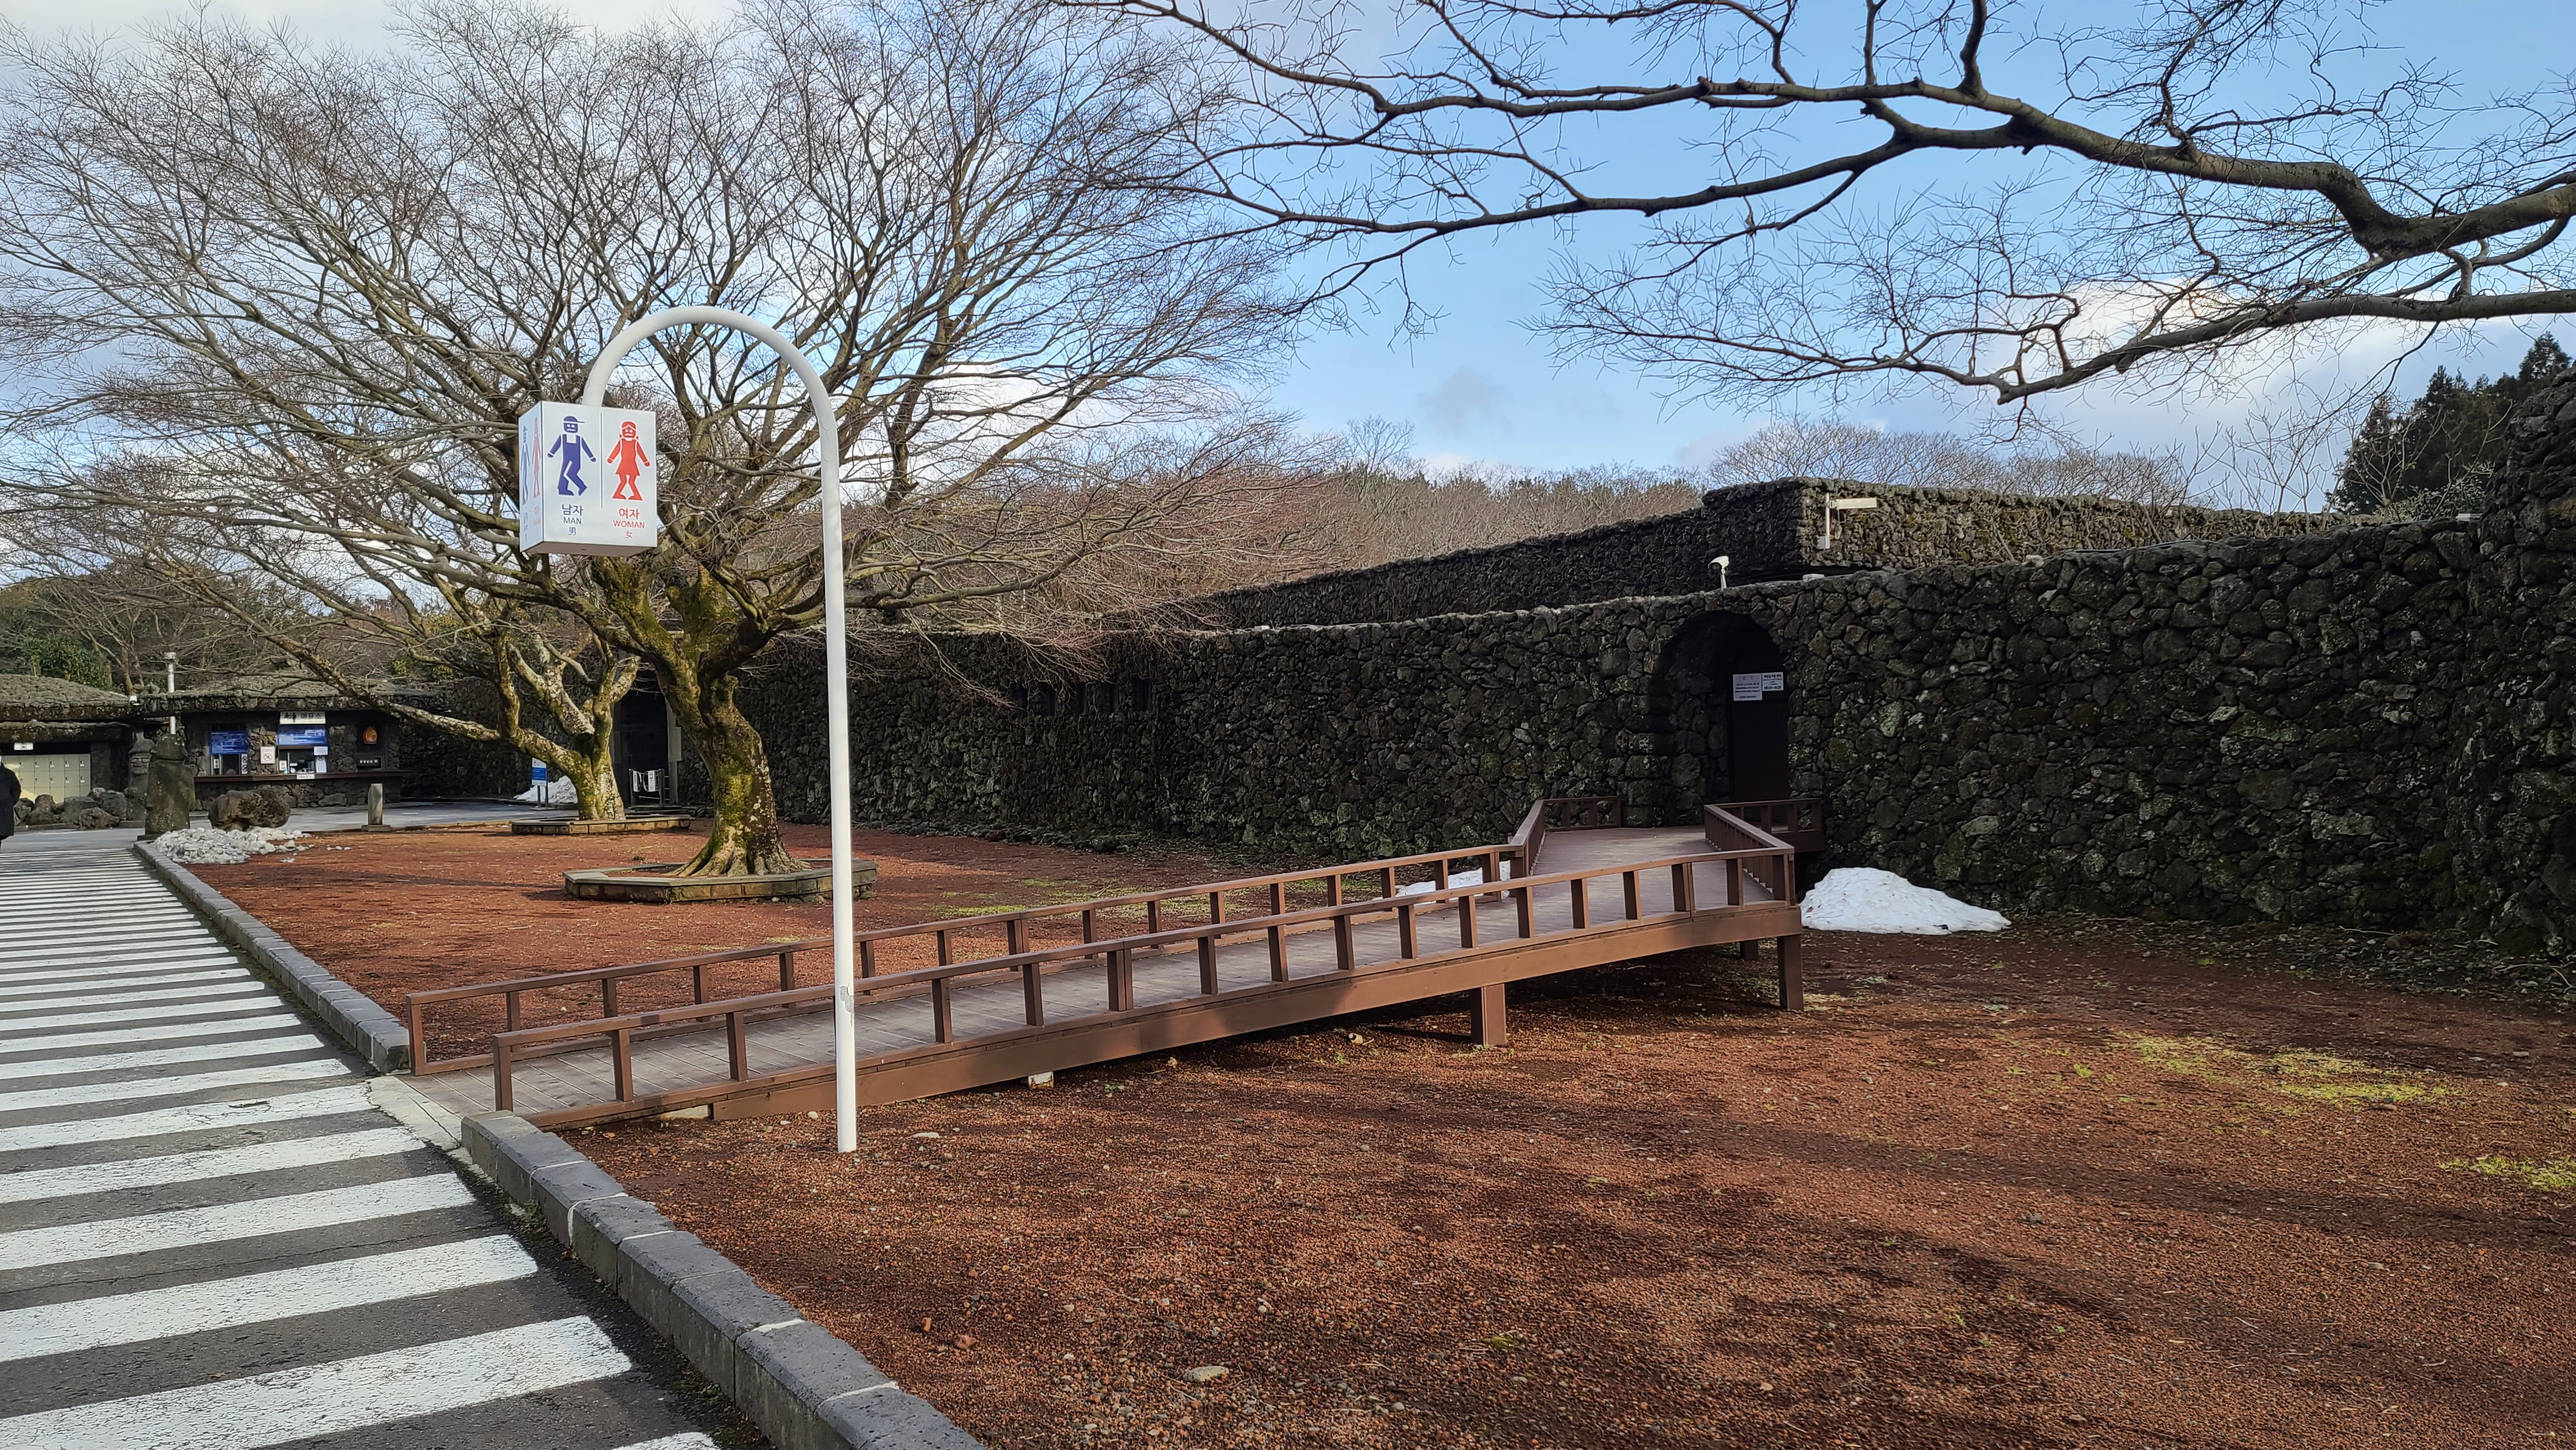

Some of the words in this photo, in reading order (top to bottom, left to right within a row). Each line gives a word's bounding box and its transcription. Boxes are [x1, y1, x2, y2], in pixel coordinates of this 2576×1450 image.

[562, 504, 583, 516] 남자
[618, 508, 640, 520] 여자
[612, 520, 645, 529] WOMAN
[568, 527, 576, 536] 男
[625, 531, 633, 539] 女
